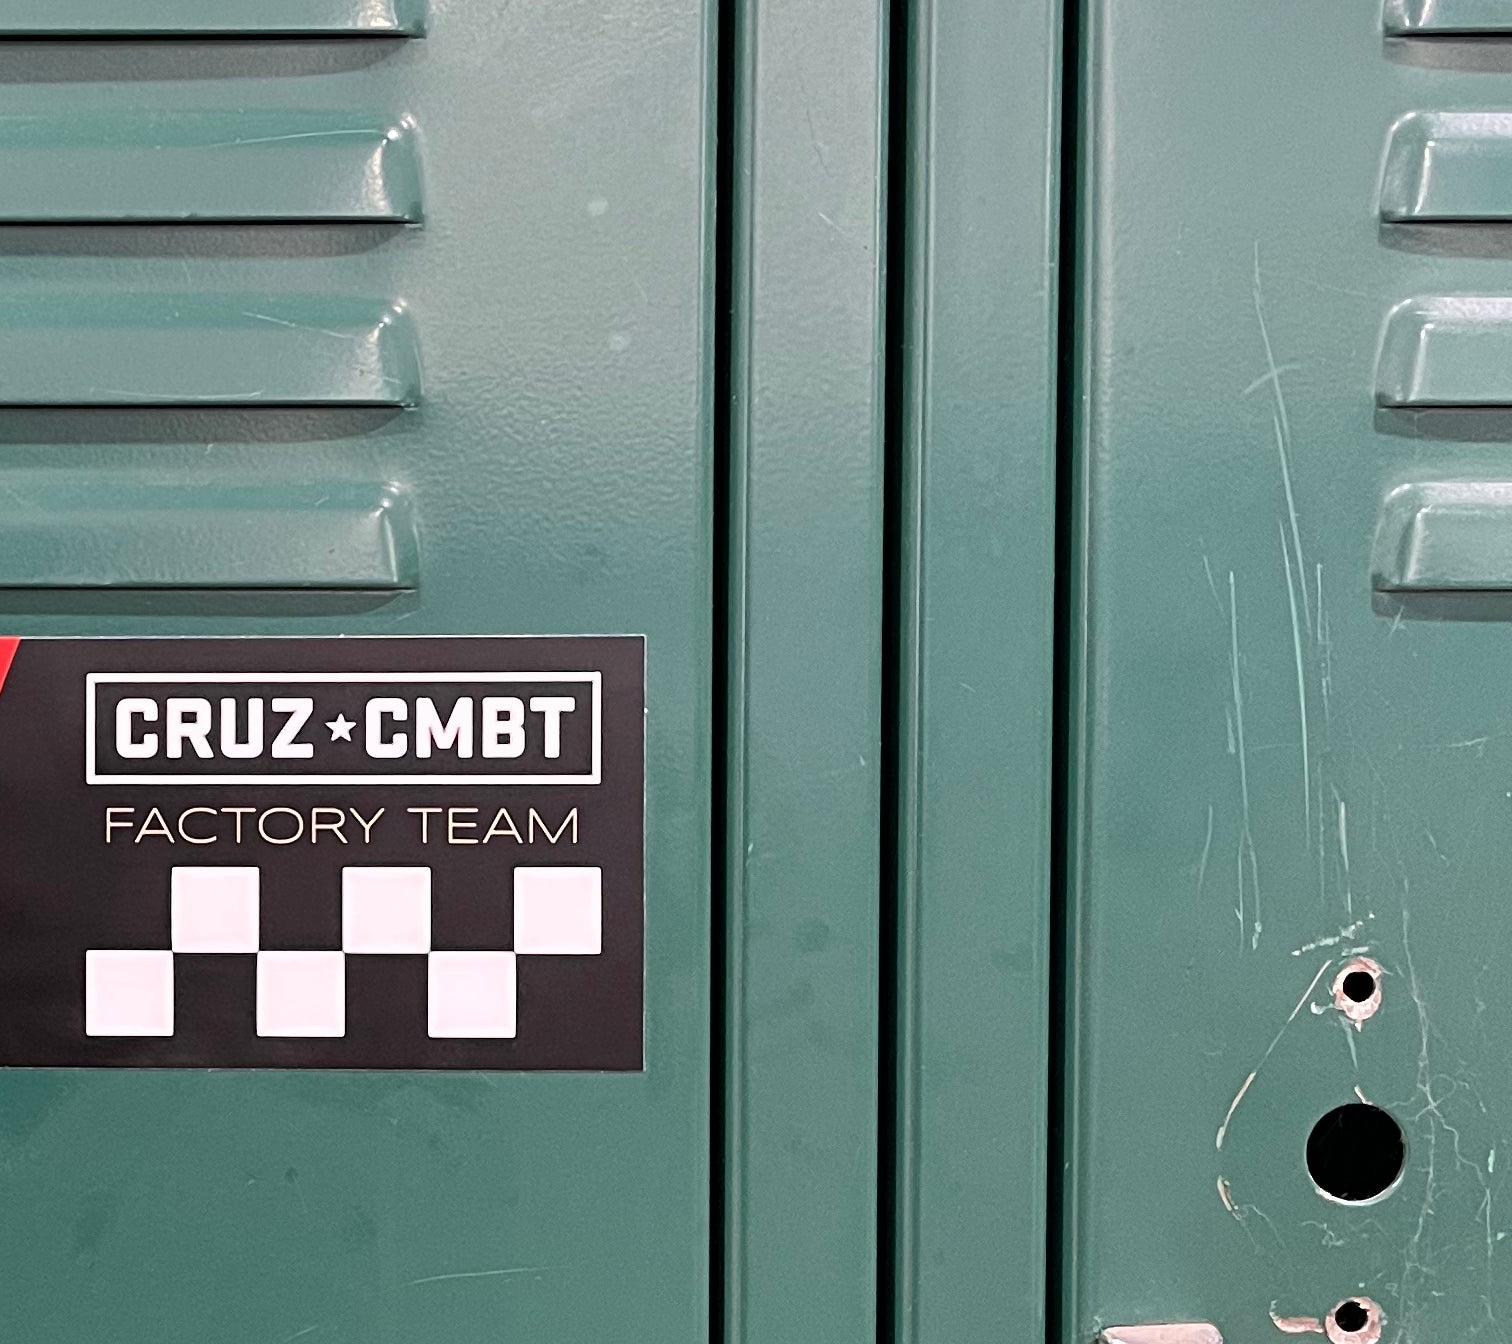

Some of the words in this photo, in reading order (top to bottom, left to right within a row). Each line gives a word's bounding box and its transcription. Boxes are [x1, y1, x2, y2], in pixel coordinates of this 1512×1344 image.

[114, 697, 315, 759] CRUZ
[364, 696, 577, 759] CMBT
[104, 807, 386, 845] FACTORY
[406, 807, 580, 844] TEAM
